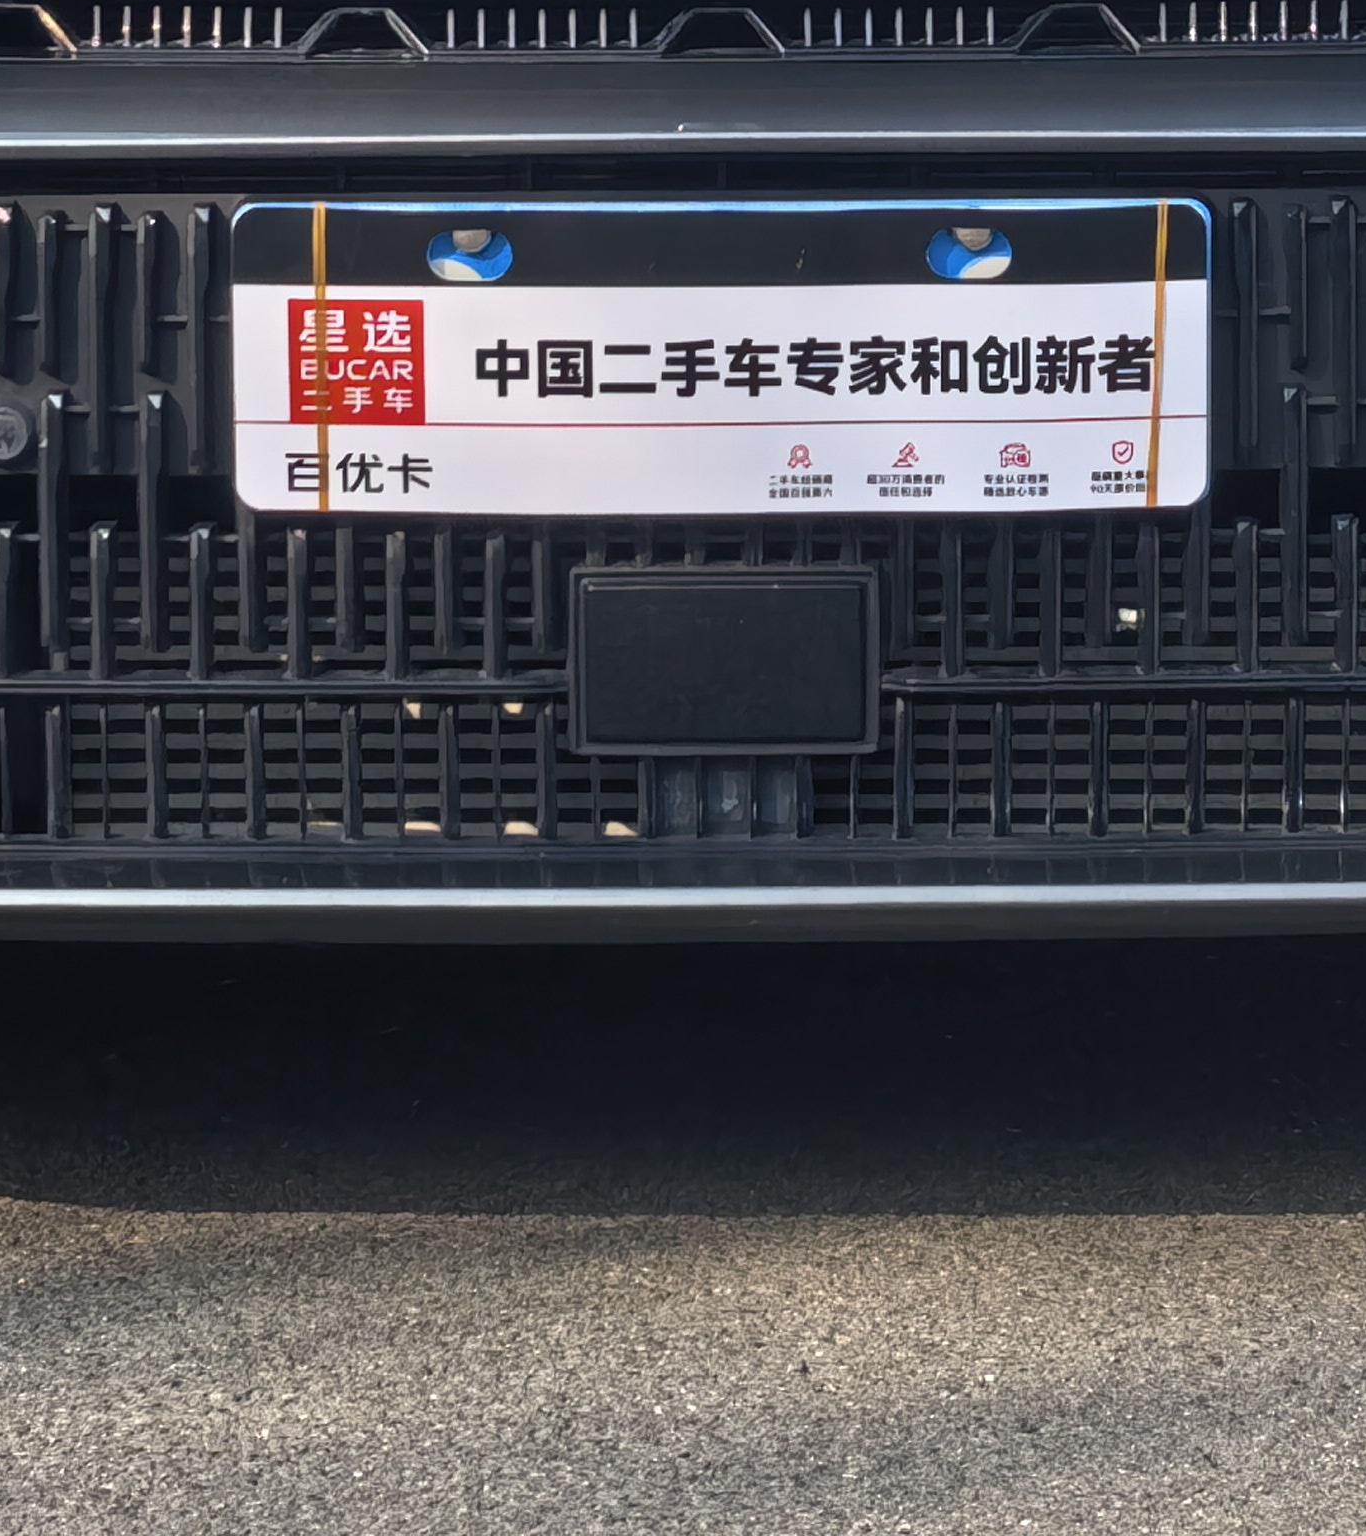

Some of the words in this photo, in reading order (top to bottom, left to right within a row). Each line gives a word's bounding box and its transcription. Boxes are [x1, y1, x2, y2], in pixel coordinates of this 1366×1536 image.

[299, 309, 412, 352] 星选
[475, 335, 1156, 398] 中国二手车专家和创新者
[300, 386, 414, 414] 二手车
[285, 452, 433, 495] 百优卡
